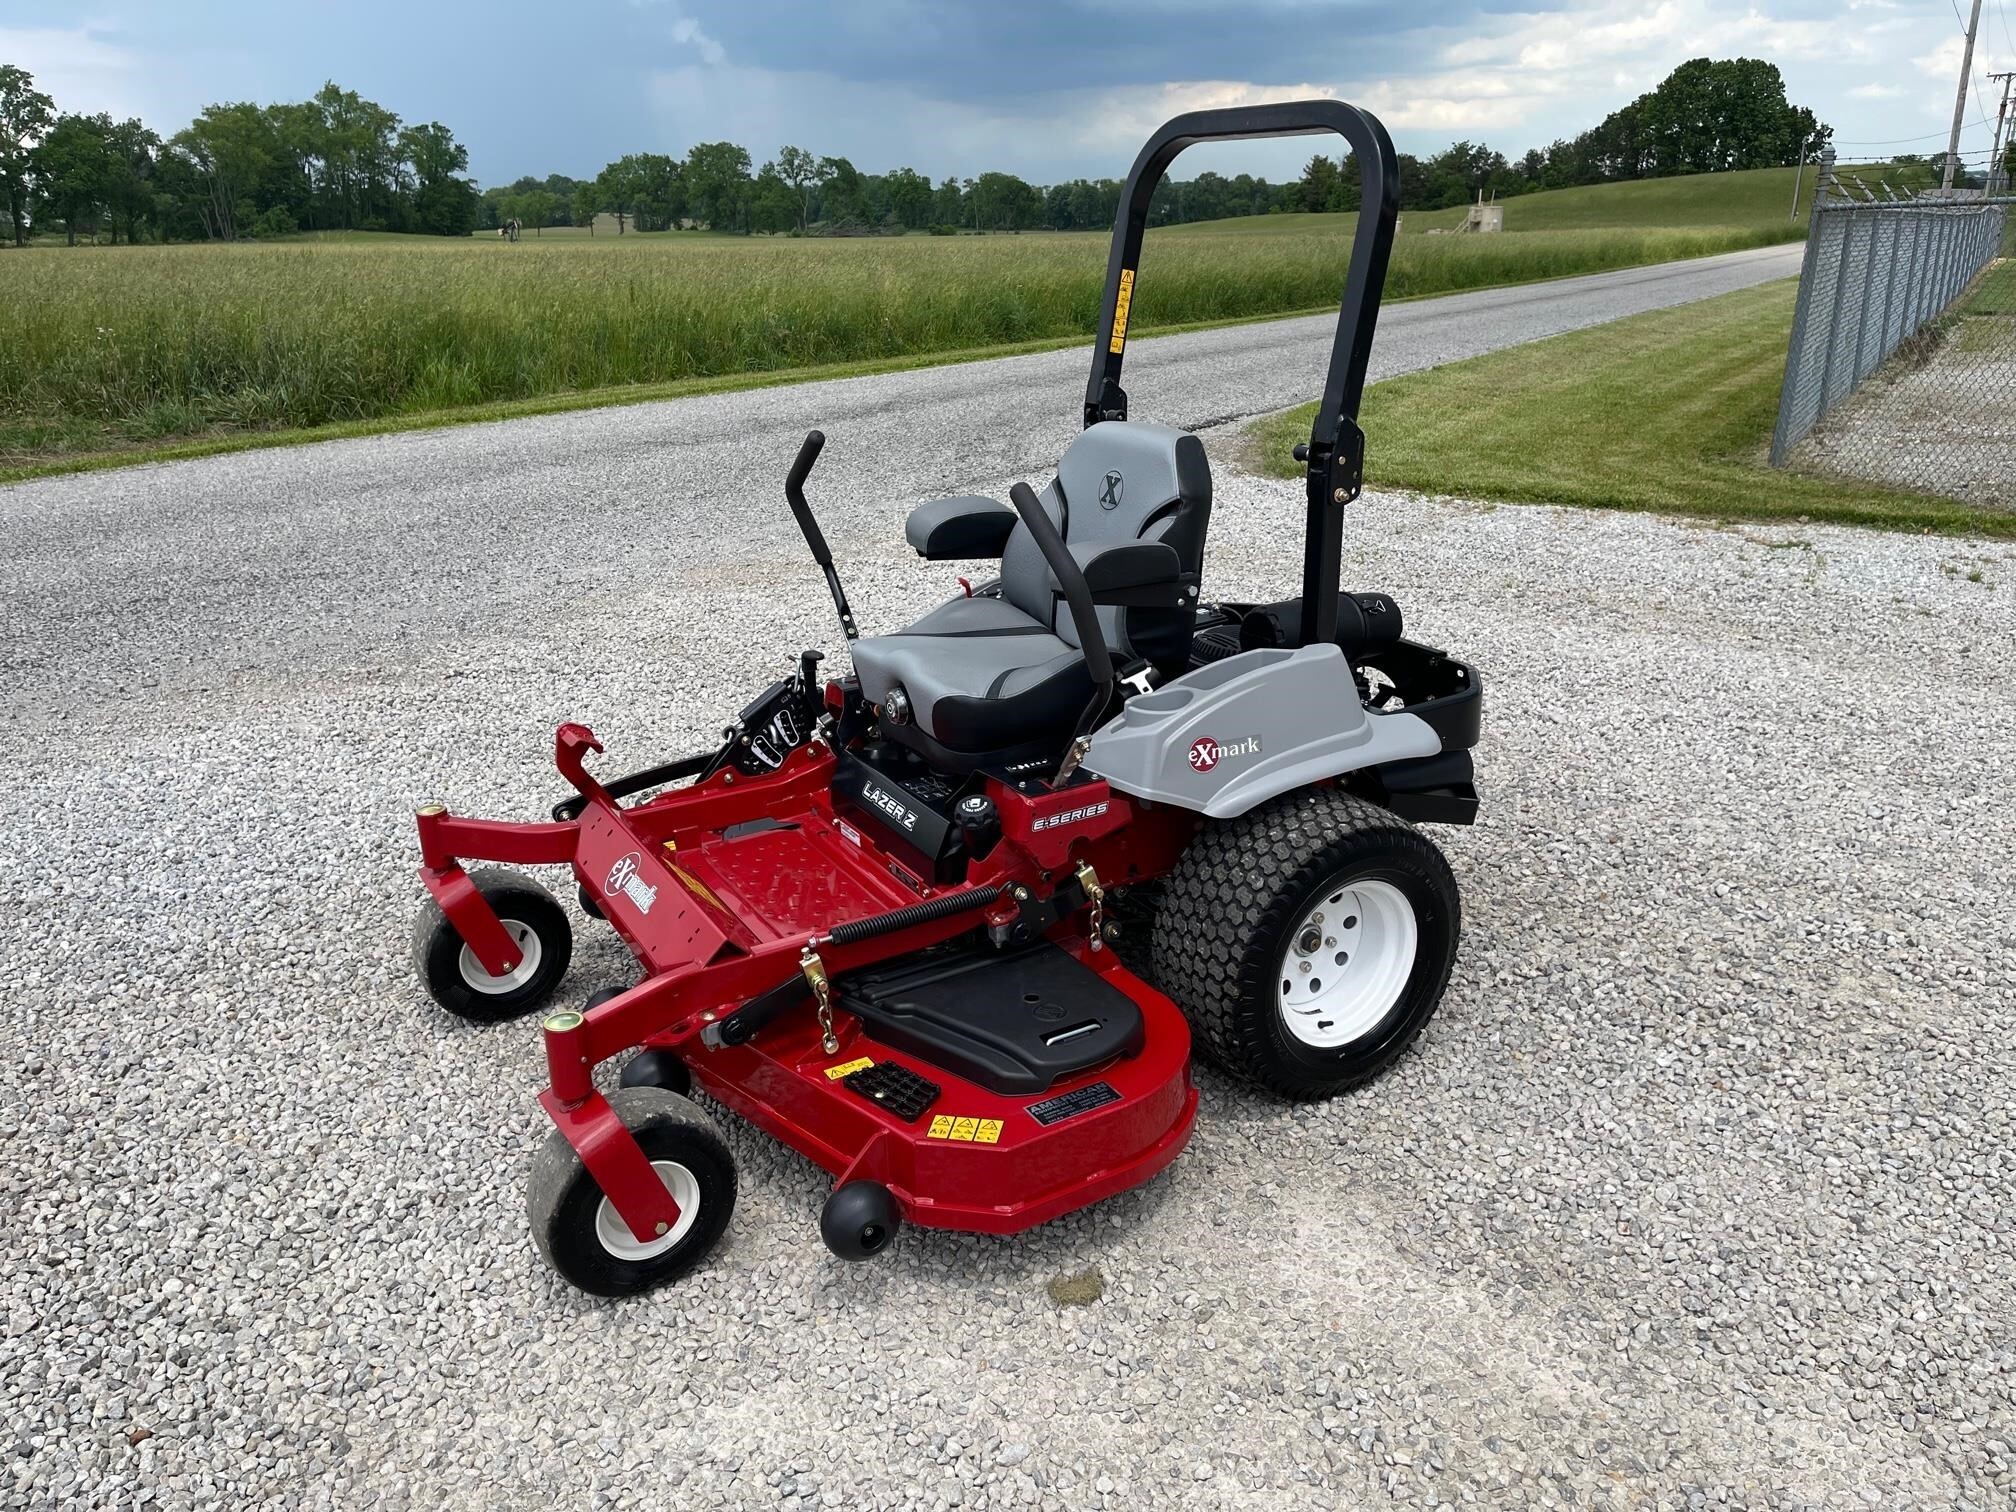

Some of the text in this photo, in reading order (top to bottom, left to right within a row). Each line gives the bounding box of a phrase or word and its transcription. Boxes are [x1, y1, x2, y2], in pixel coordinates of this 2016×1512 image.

[1188, 738, 1260, 766] eXmark
[862, 782, 917, 830] LAZER Z
[1033, 802, 1108, 831] E-SERIES
[609, 857, 657, 913] eXmark
[1030, 1083, 1107, 1114] AMERICAN
